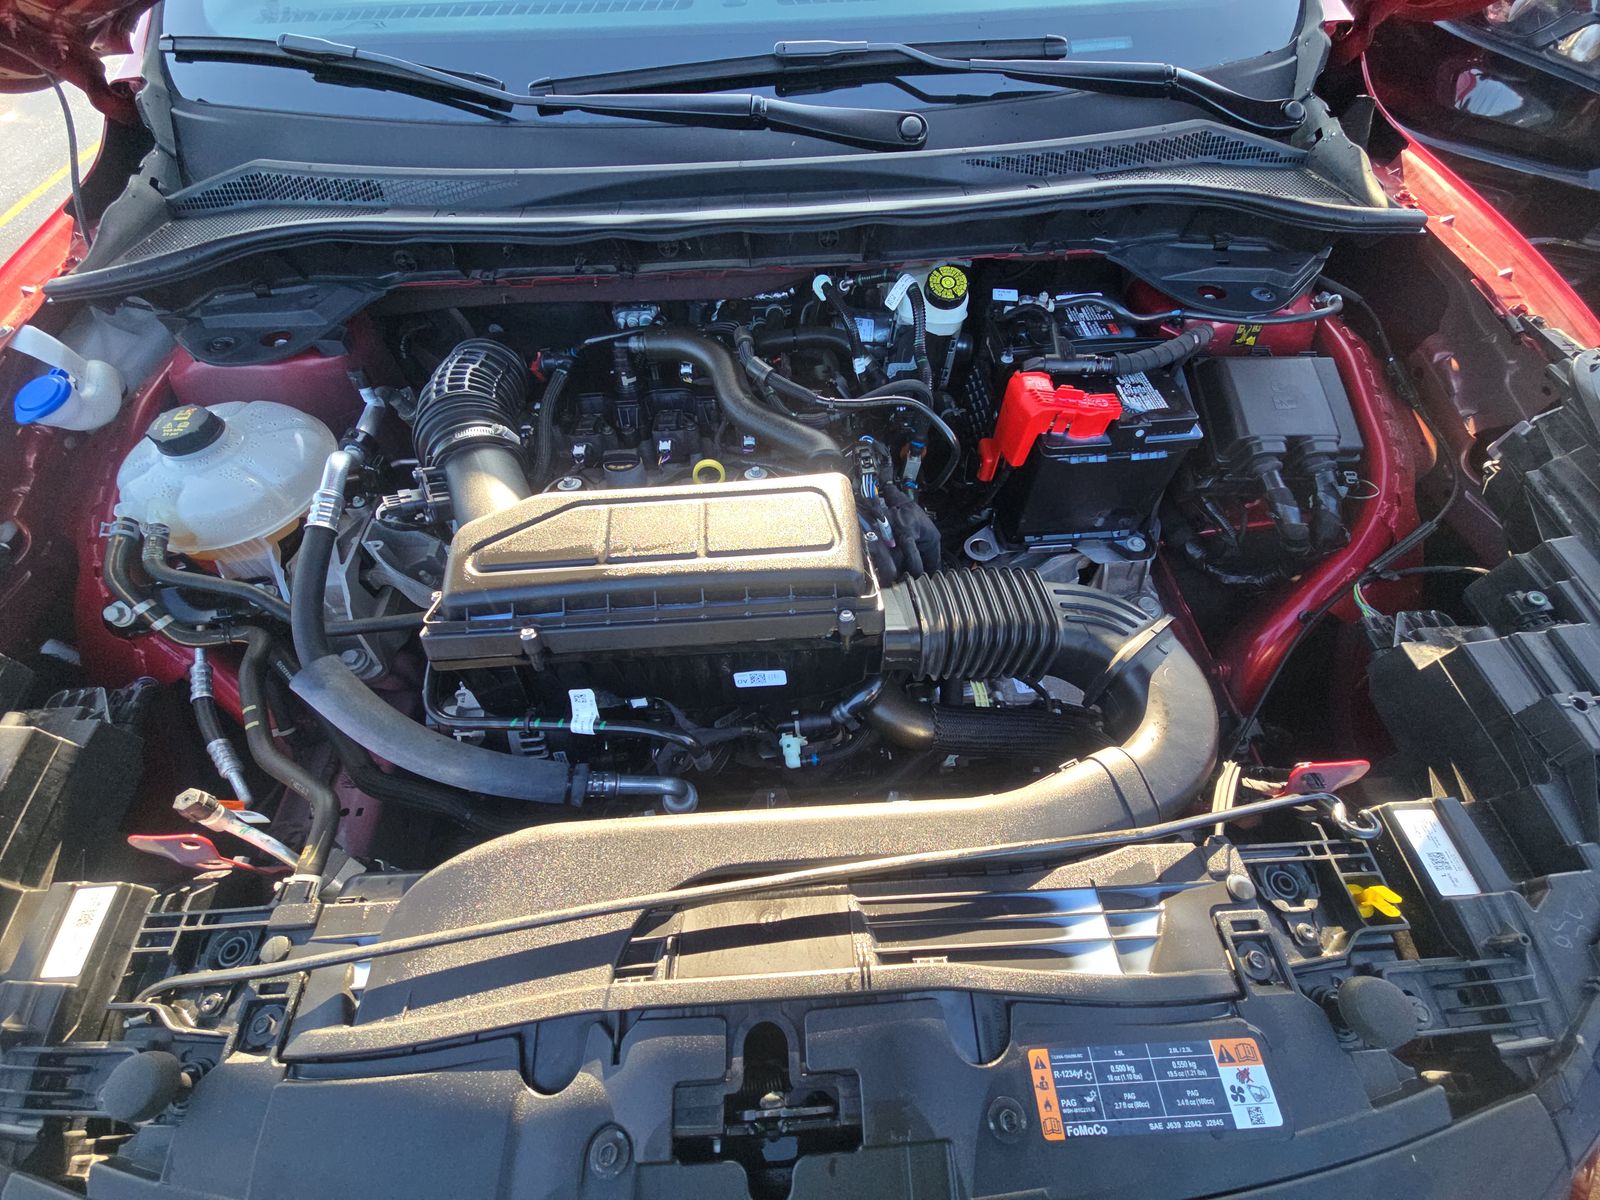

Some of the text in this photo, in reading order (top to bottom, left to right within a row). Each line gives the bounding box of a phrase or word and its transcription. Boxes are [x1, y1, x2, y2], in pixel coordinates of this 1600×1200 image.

[1110, 1063, 1135, 1074] 0.500 kg
[1172, 1060, 1197, 1070] 0.550 kg
[1054, 1069, 1083, 1079] R-1234yf
[1197, 1069, 1207, 1077] lbs)
[1123, 1092, 1136, 1100] PAG
[1186, 1089, 1199, 1097] PAG
[1061, 1099, 1077, 1107] PAG
[1114, 1102, 1122, 1110] 2.7
[1166, 1121, 1181, 1129] J639
[1184, 1120, 1202, 1128] J2842
[1206, 1119, 1224, 1127] J2845
[1066, 1124, 1108, 1137] FoMoCo
